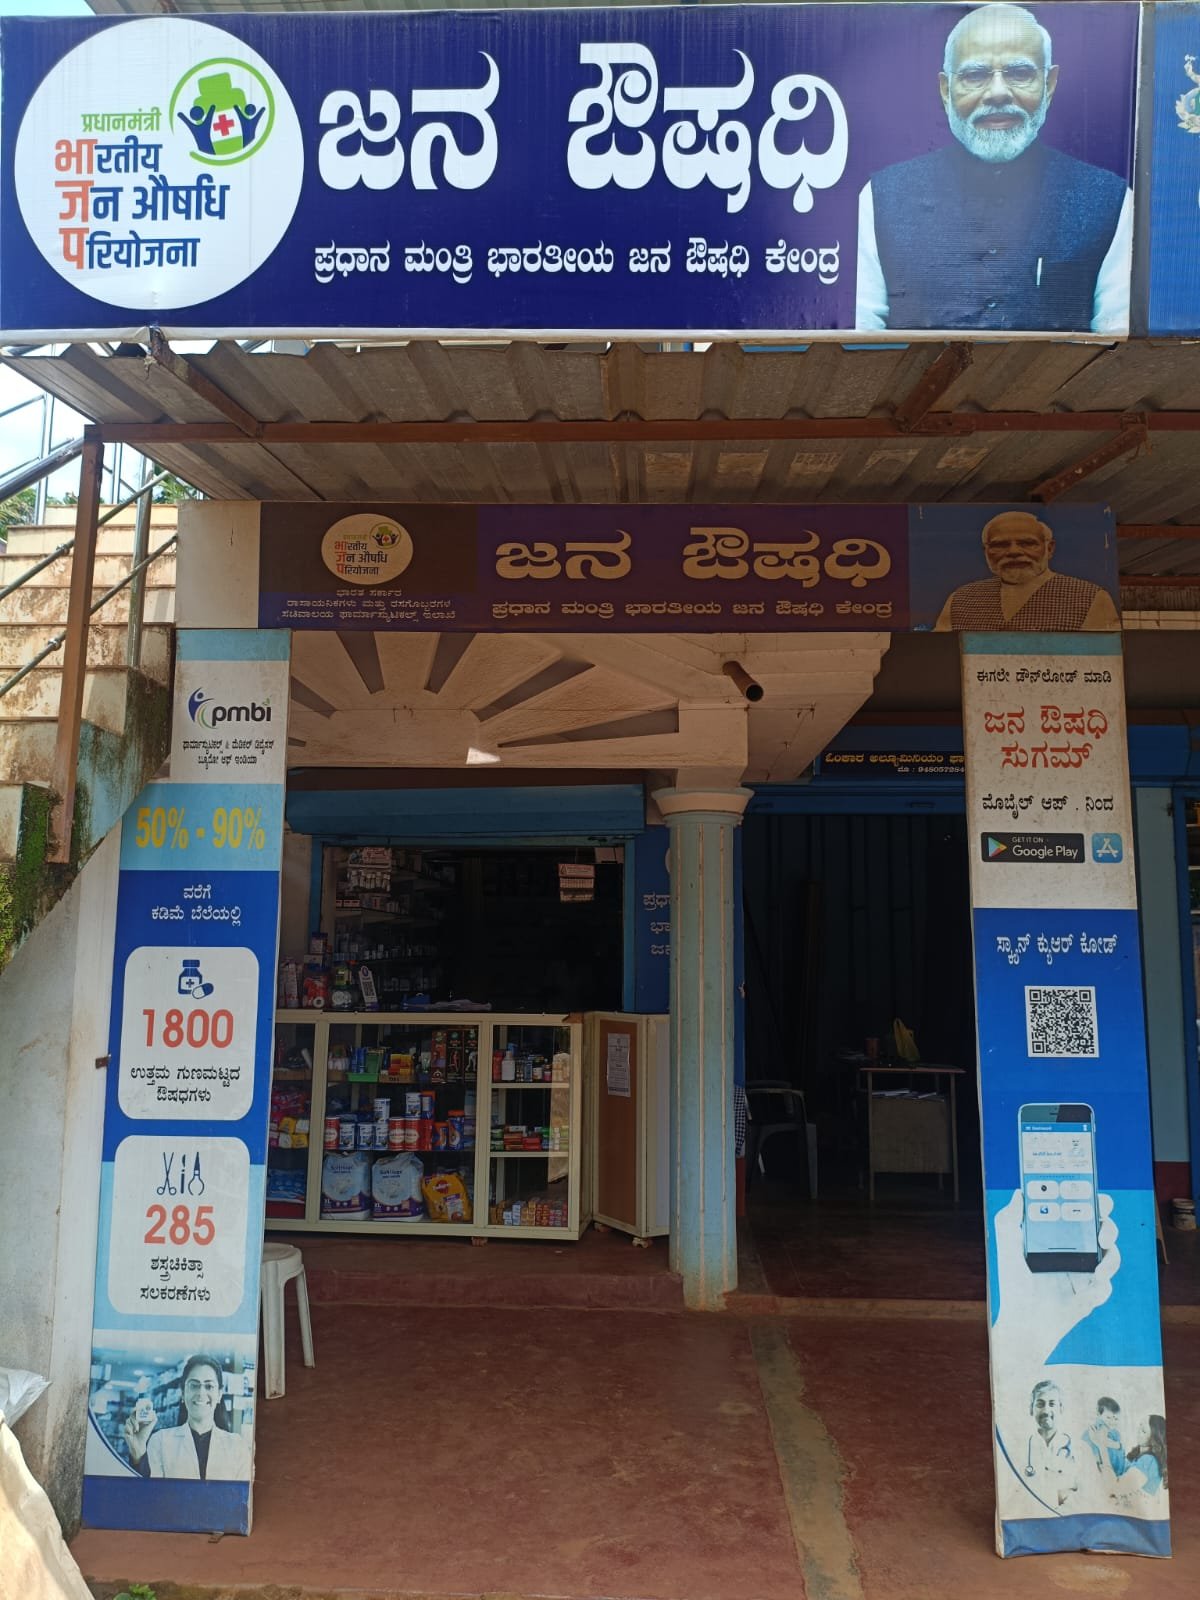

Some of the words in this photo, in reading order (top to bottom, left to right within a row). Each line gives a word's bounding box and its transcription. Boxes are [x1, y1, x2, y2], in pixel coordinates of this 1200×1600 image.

[81, 107, 162, 134] प्रधानमंत्री
[318, 50, 500, 191] ಜನ
[567, 42, 849, 213] ಔಷಧಿ
[55, 135, 162, 175] भारतीय
[55, 179, 123, 223] जन
[131, 174, 230, 221] औषधि
[59, 227, 201, 270] परियोजना
[314, 240, 390, 284] ಪ್ರಧಾನ
[404, 240, 473, 284] ಮಂತ್ರಿ
[487, 240, 613, 275] ಭಾರತೀಯ
[629, 241, 671, 275] ಜನ
[686, 237, 751, 279] ಔಷಧಿ
[765, 240, 840, 285] ಕೇಂದ್ರ
[495, 530, 631, 580] ಜನ
[682, 527, 891, 588] ಔಷಧಿ
[492, 601, 551, 618] ಪ್ರಧಾನ
[562, 601, 614, 618] ಮಂತ್ರಿ
[625, 602, 721, 615] ಭಾರತೀಯ
[732, 602, 764, 615] ಜನ
[775, 601, 824, 616] ಔಷಧಿ
[835, 601, 893, 618] ಕೇಂದ್ರ
[1084, 669, 1112, 684] ಮಾಡಿ
[211, 698, 272, 727] pmbi
[984, 706, 1025, 734] ಜನ
[1040, 705, 1108, 740] ಔಷಧಿ
[1001, 740, 1094, 769] ಸುಗಮ್
[982, 793, 1034, 819] ಮೊಬೈಲ್
[1085, 795, 1114, 811] ನಿಂದ
[135, 806, 189, 850] 50%
[212, 806, 265, 850] 90%
[1012, 845, 1054, 858] Google
[1055, 845, 1079, 859] Play
[183, 885, 212, 900] ವರೆಗೆ
[151, 906, 184, 920] ಕಡಿಮೆ
[1080, 931, 1118, 954] ಕೋಡ್
[142, 1008, 234, 1049] 1800
[131, 1064, 170, 1086] ಉತ್ತಮ
[177, 1065, 241, 1088] ಗುಣಮಟ್ಟದ
[143, 1204, 216, 1246] 285
